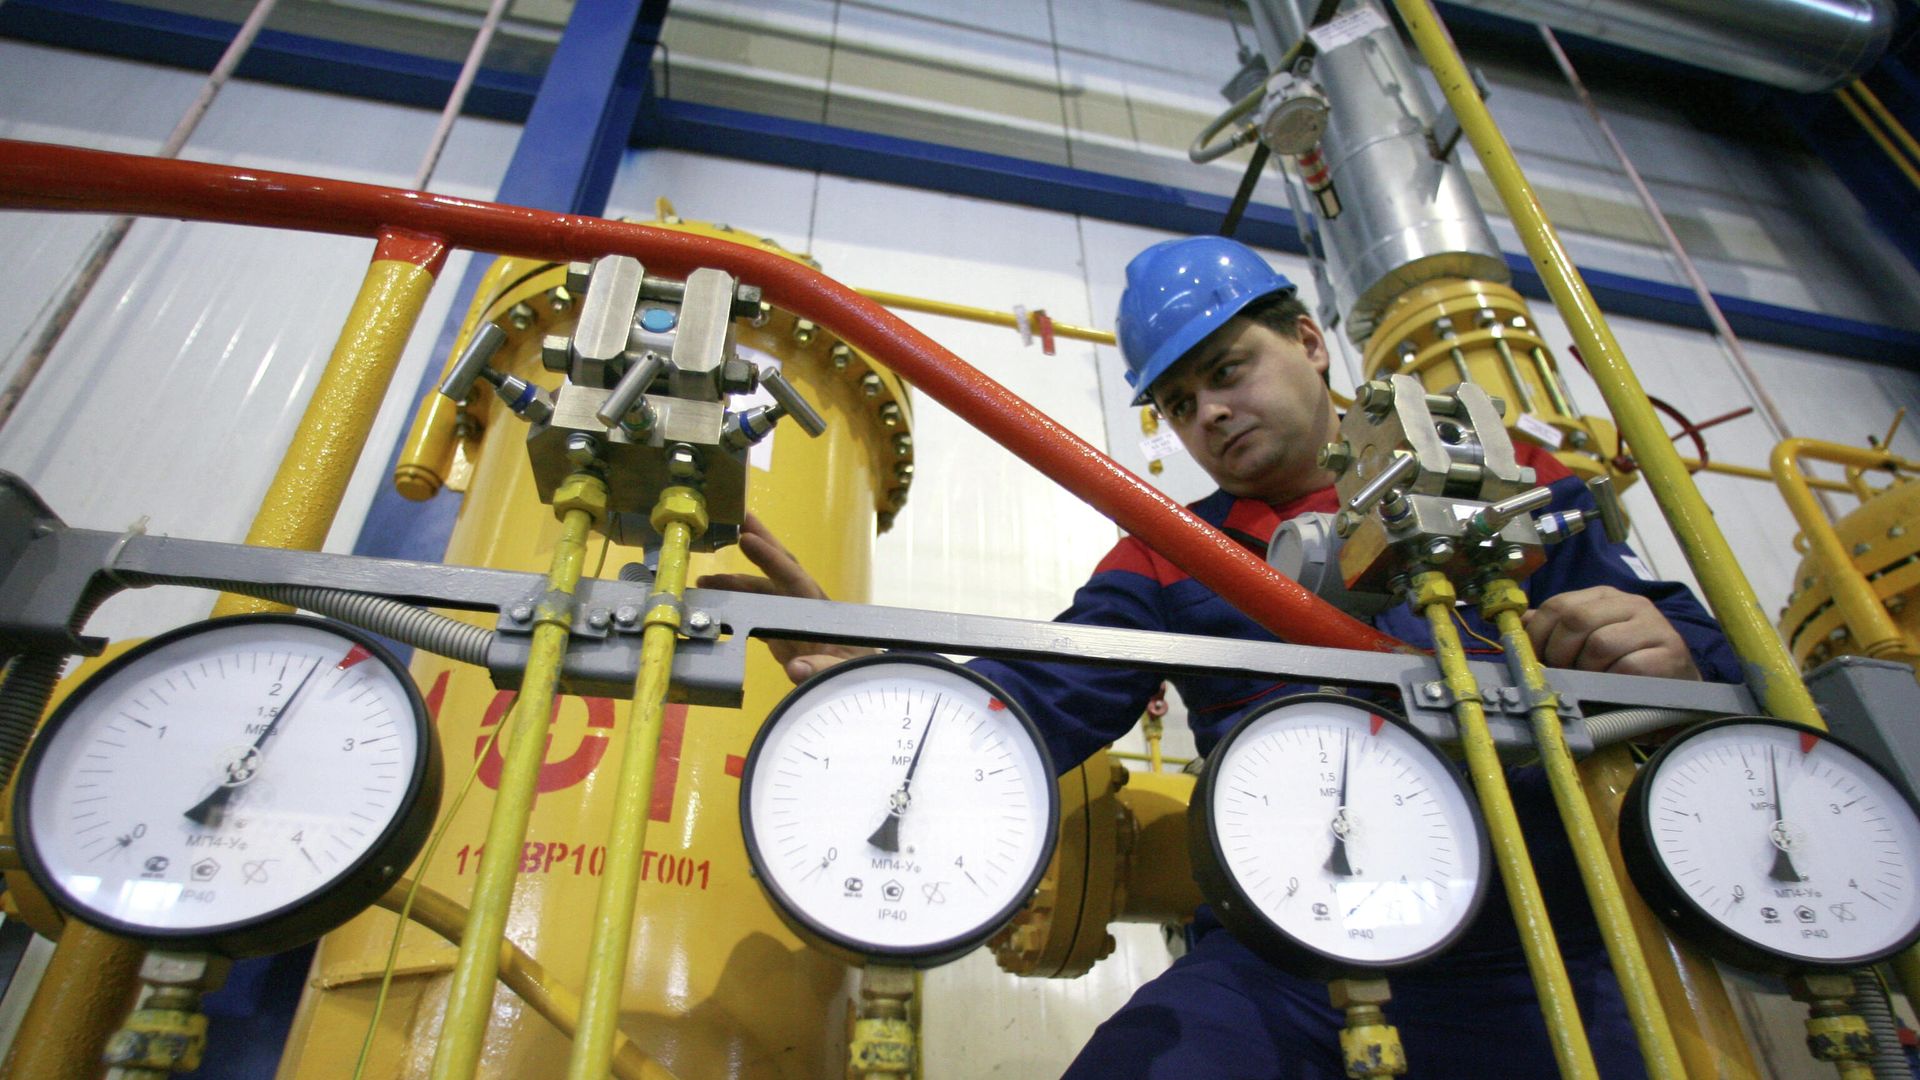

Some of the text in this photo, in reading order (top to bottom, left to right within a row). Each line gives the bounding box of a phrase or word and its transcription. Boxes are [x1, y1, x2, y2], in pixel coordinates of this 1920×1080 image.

[269, 682, 283, 697] 2
[901, 716, 912, 730] 2
[157, 725, 167, 739] 1
[342, 737, 355, 752] 3
[897, 738, 914, 750] 1,5
[823, 757, 830, 770] 1
[1318, 751, 1329, 764] 2
[974, 768, 985, 782] 3
[1319, 772, 1336, 783] 1,5
[1744, 769, 1756, 781] 2
[1262, 794, 1269, 807] 1
[1394, 793, 1404, 807] 3
[1830, 802, 1842, 815] 3
[1694, 812, 1702, 824] 1
[132, 823, 147, 839] 0
[291, 830, 305, 845] 4
[827, 847, 838, 861] 0
[954, 855, 965, 869] 4
[1289, 876, 1299, 893] 0
[1733, 884, 1745, 898] 0
[1847, 878, 1859, 890] 4
[878, 907, 908, 922] IP40
[1347, 928, 1375, 940] IP40
[1801, 928, 1829, 939] IP40
